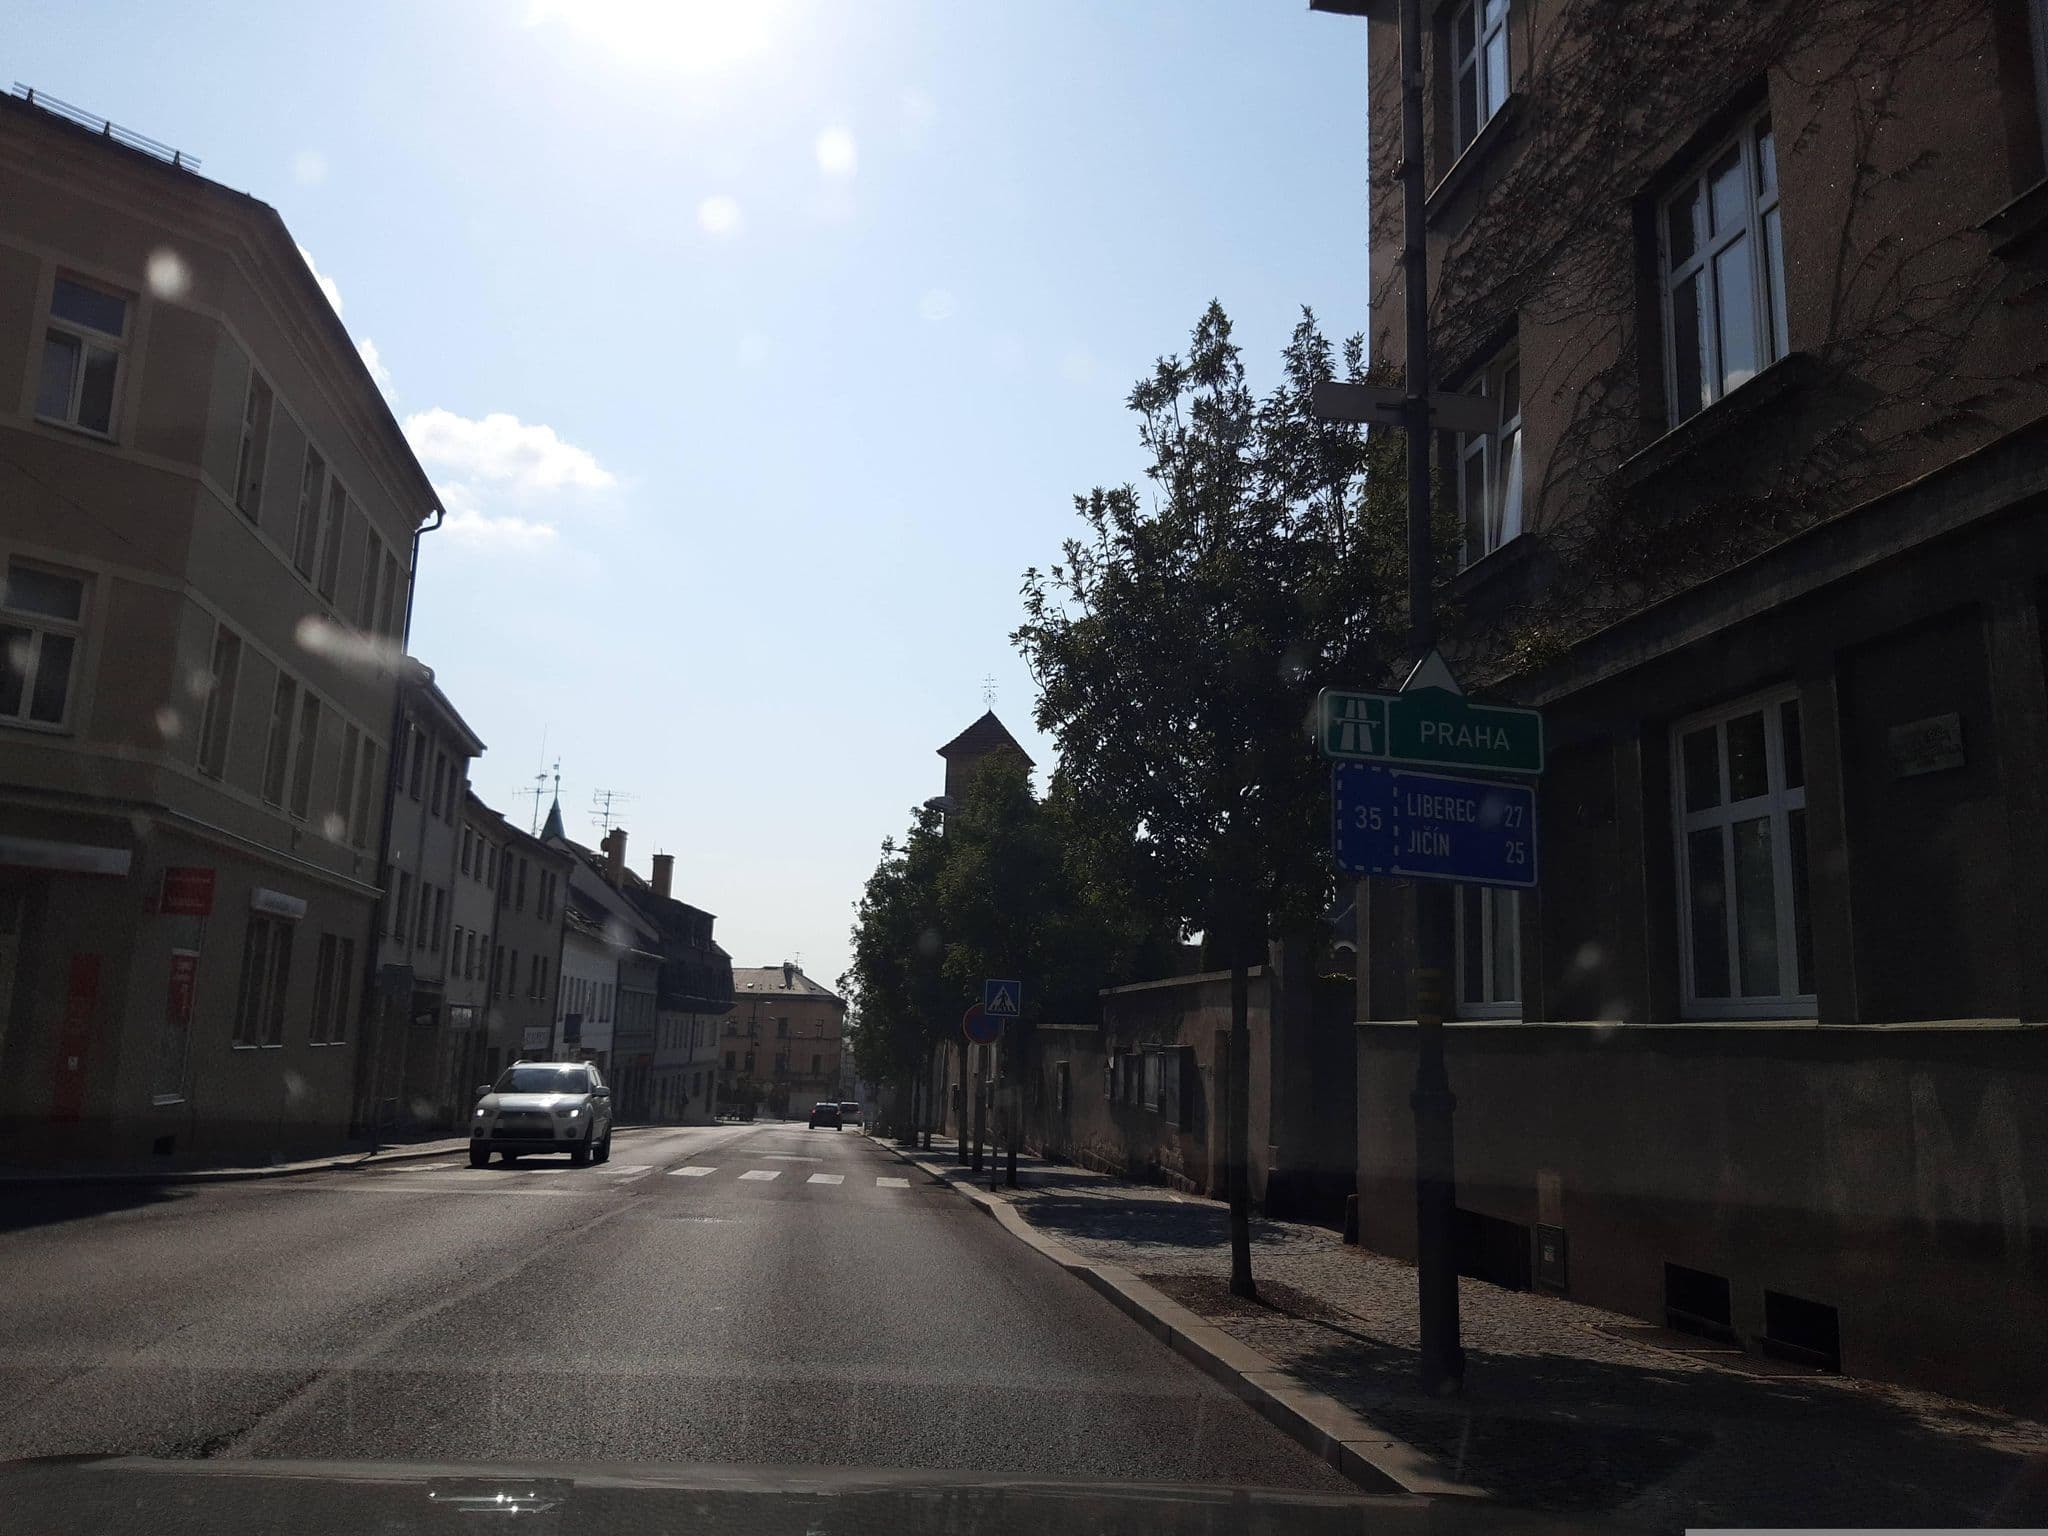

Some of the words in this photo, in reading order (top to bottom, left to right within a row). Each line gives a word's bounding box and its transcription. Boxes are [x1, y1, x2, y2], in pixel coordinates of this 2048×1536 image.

[1420, 720, 1510, 751] PRAHA
[1354, 805, 1383, 831] 35
[1407, 793, 1476, 823] LIBEREC
[1504, 804, 1524, 828] 27
[1407, 826, 1450, 857] JIČÍN
[1505, 840, 1525, 865] 25
